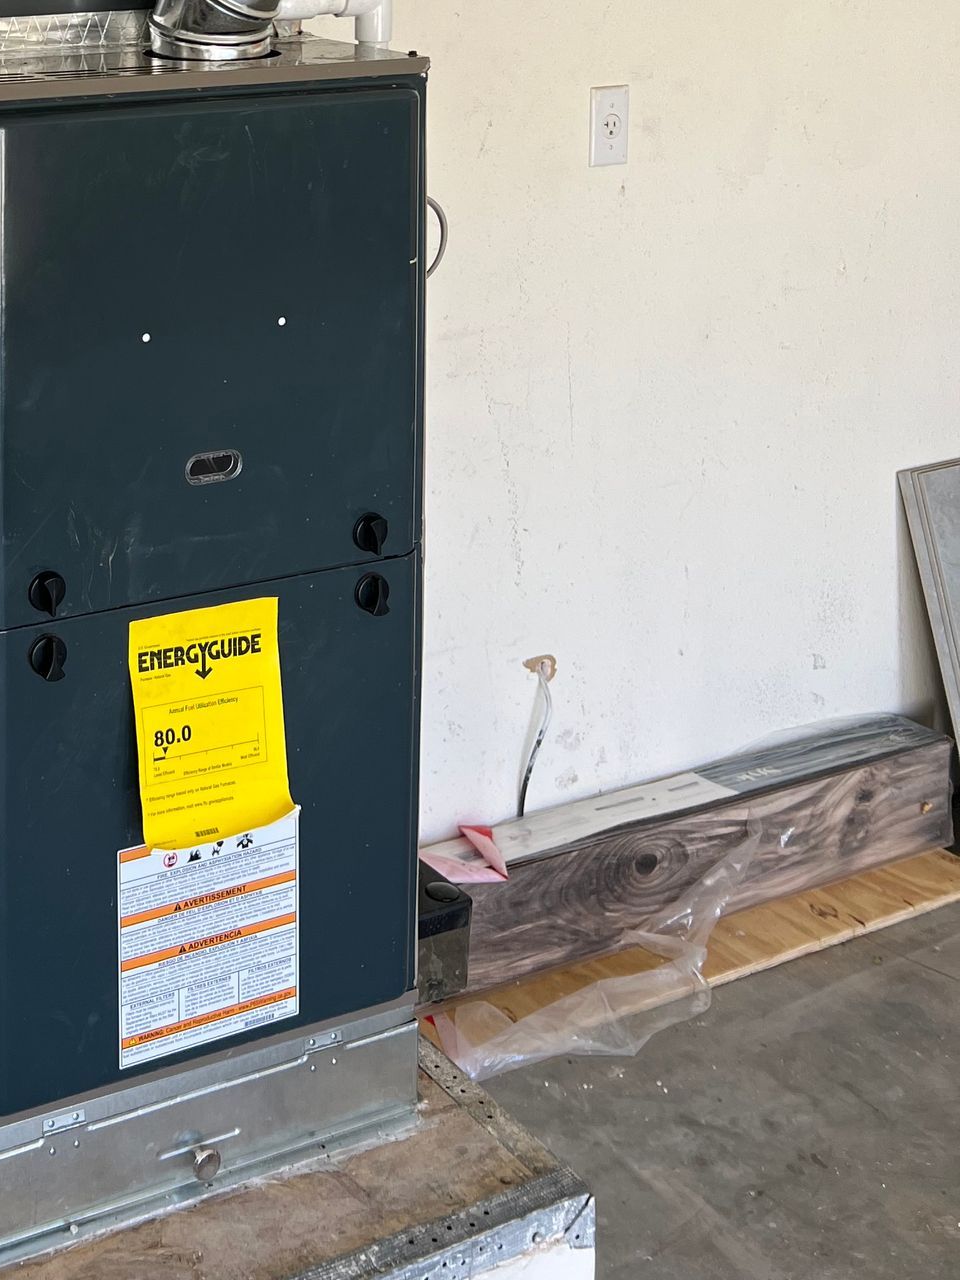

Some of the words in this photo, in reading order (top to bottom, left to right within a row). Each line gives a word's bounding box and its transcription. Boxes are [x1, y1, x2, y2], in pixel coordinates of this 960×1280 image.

[138, 634, 261, 673] ENERGYGUIDE
[196, 701, 217, 710] Utilization
[218, 696, 238, 706] Efficiency
[154, 725, 191, 747] 80.0
[243, 848, 262, 858] HAZARD
[183, 886, 246, 908] AVERTISSEMENT
[188, 930, 242, 950] ADVERTENCIA
[130, 998, 154, 1009] EXTERNAL
[156, 993, 175, 1001] FILTERS
